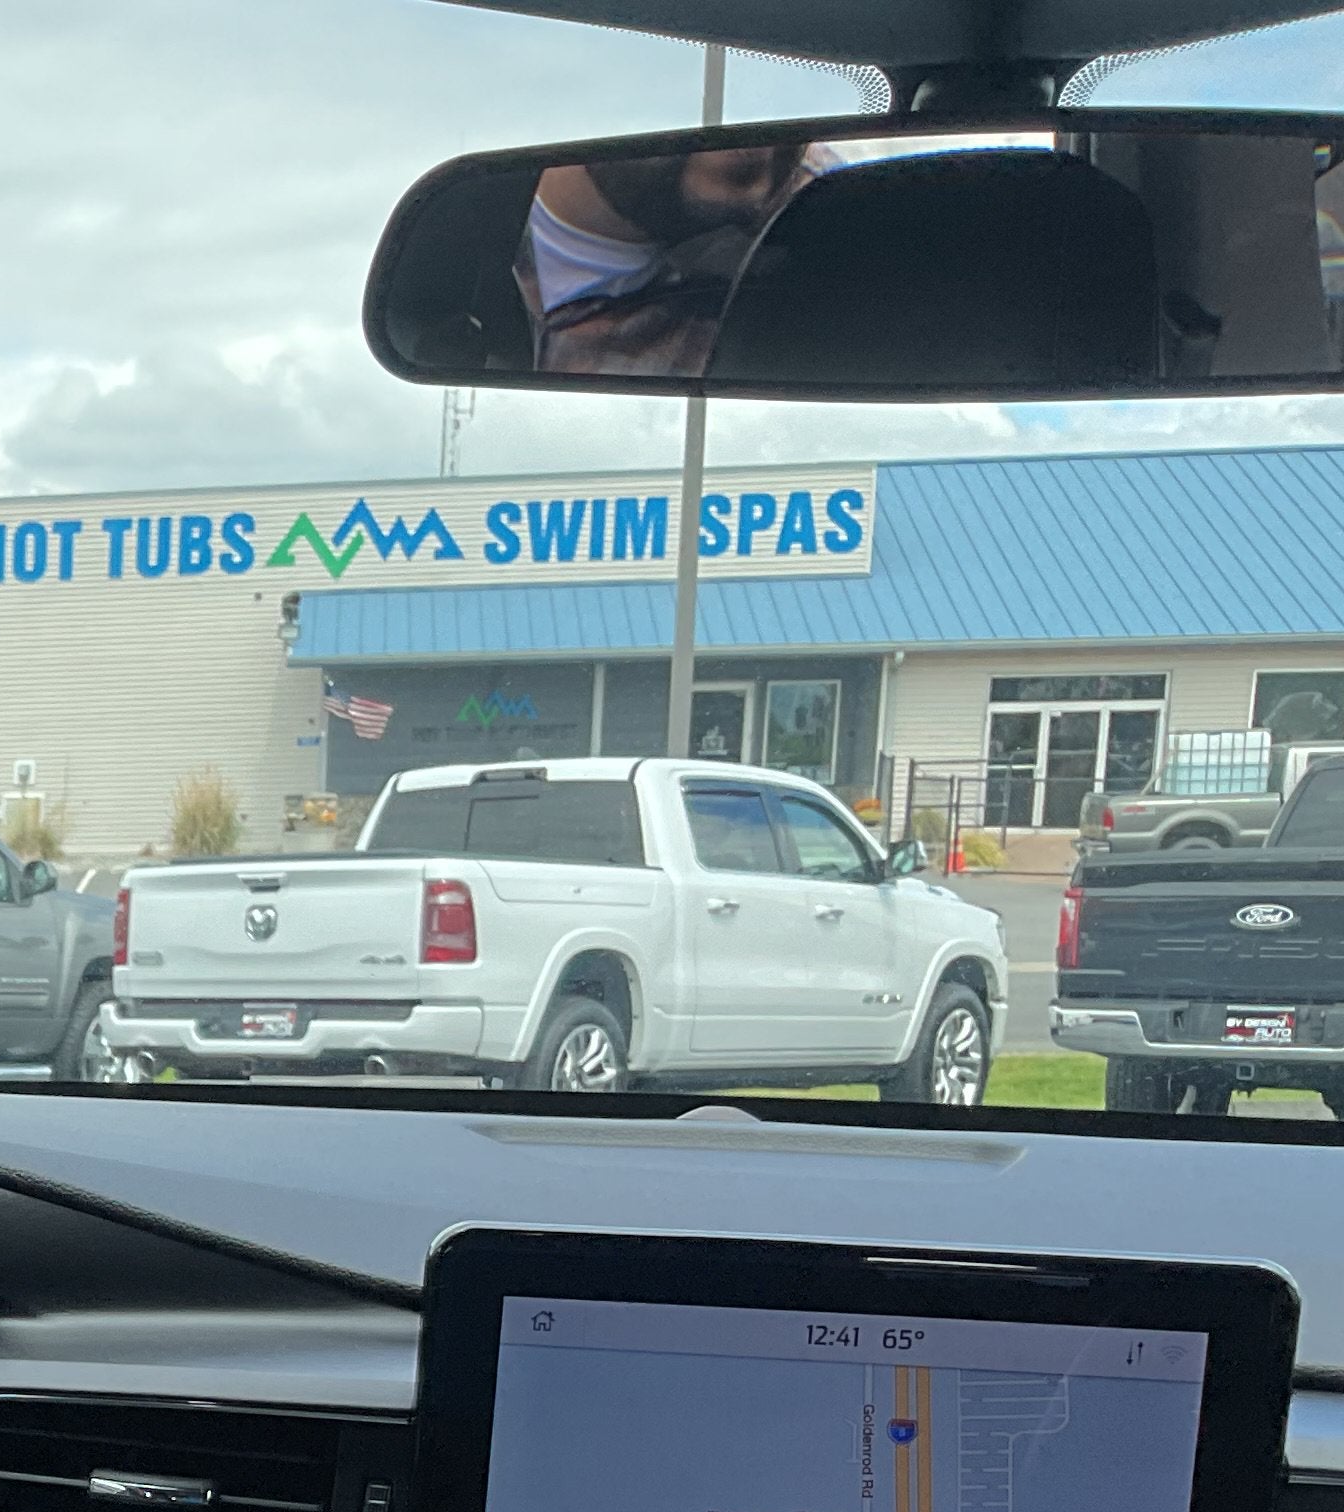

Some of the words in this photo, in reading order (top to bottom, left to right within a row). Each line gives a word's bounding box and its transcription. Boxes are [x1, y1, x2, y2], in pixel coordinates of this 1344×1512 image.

[102, 512, 256, 578] TUBS
[483, 497, 669, 565] SWIM
[698, 489, 864, 557] SPAS
[1226, 1018, 1243, 1027] BY
[1245, 1017, 1286, 1028] DESIGN
[1255, 1027, 1292, 1038] AUTO
[806, 1325, 860, 1347] 12:41
[882, 1329, 925, 1350] 65°
[862, 1404, 875, 1476] Goldenrod
[862, 1479, 874, 1499] Rd
